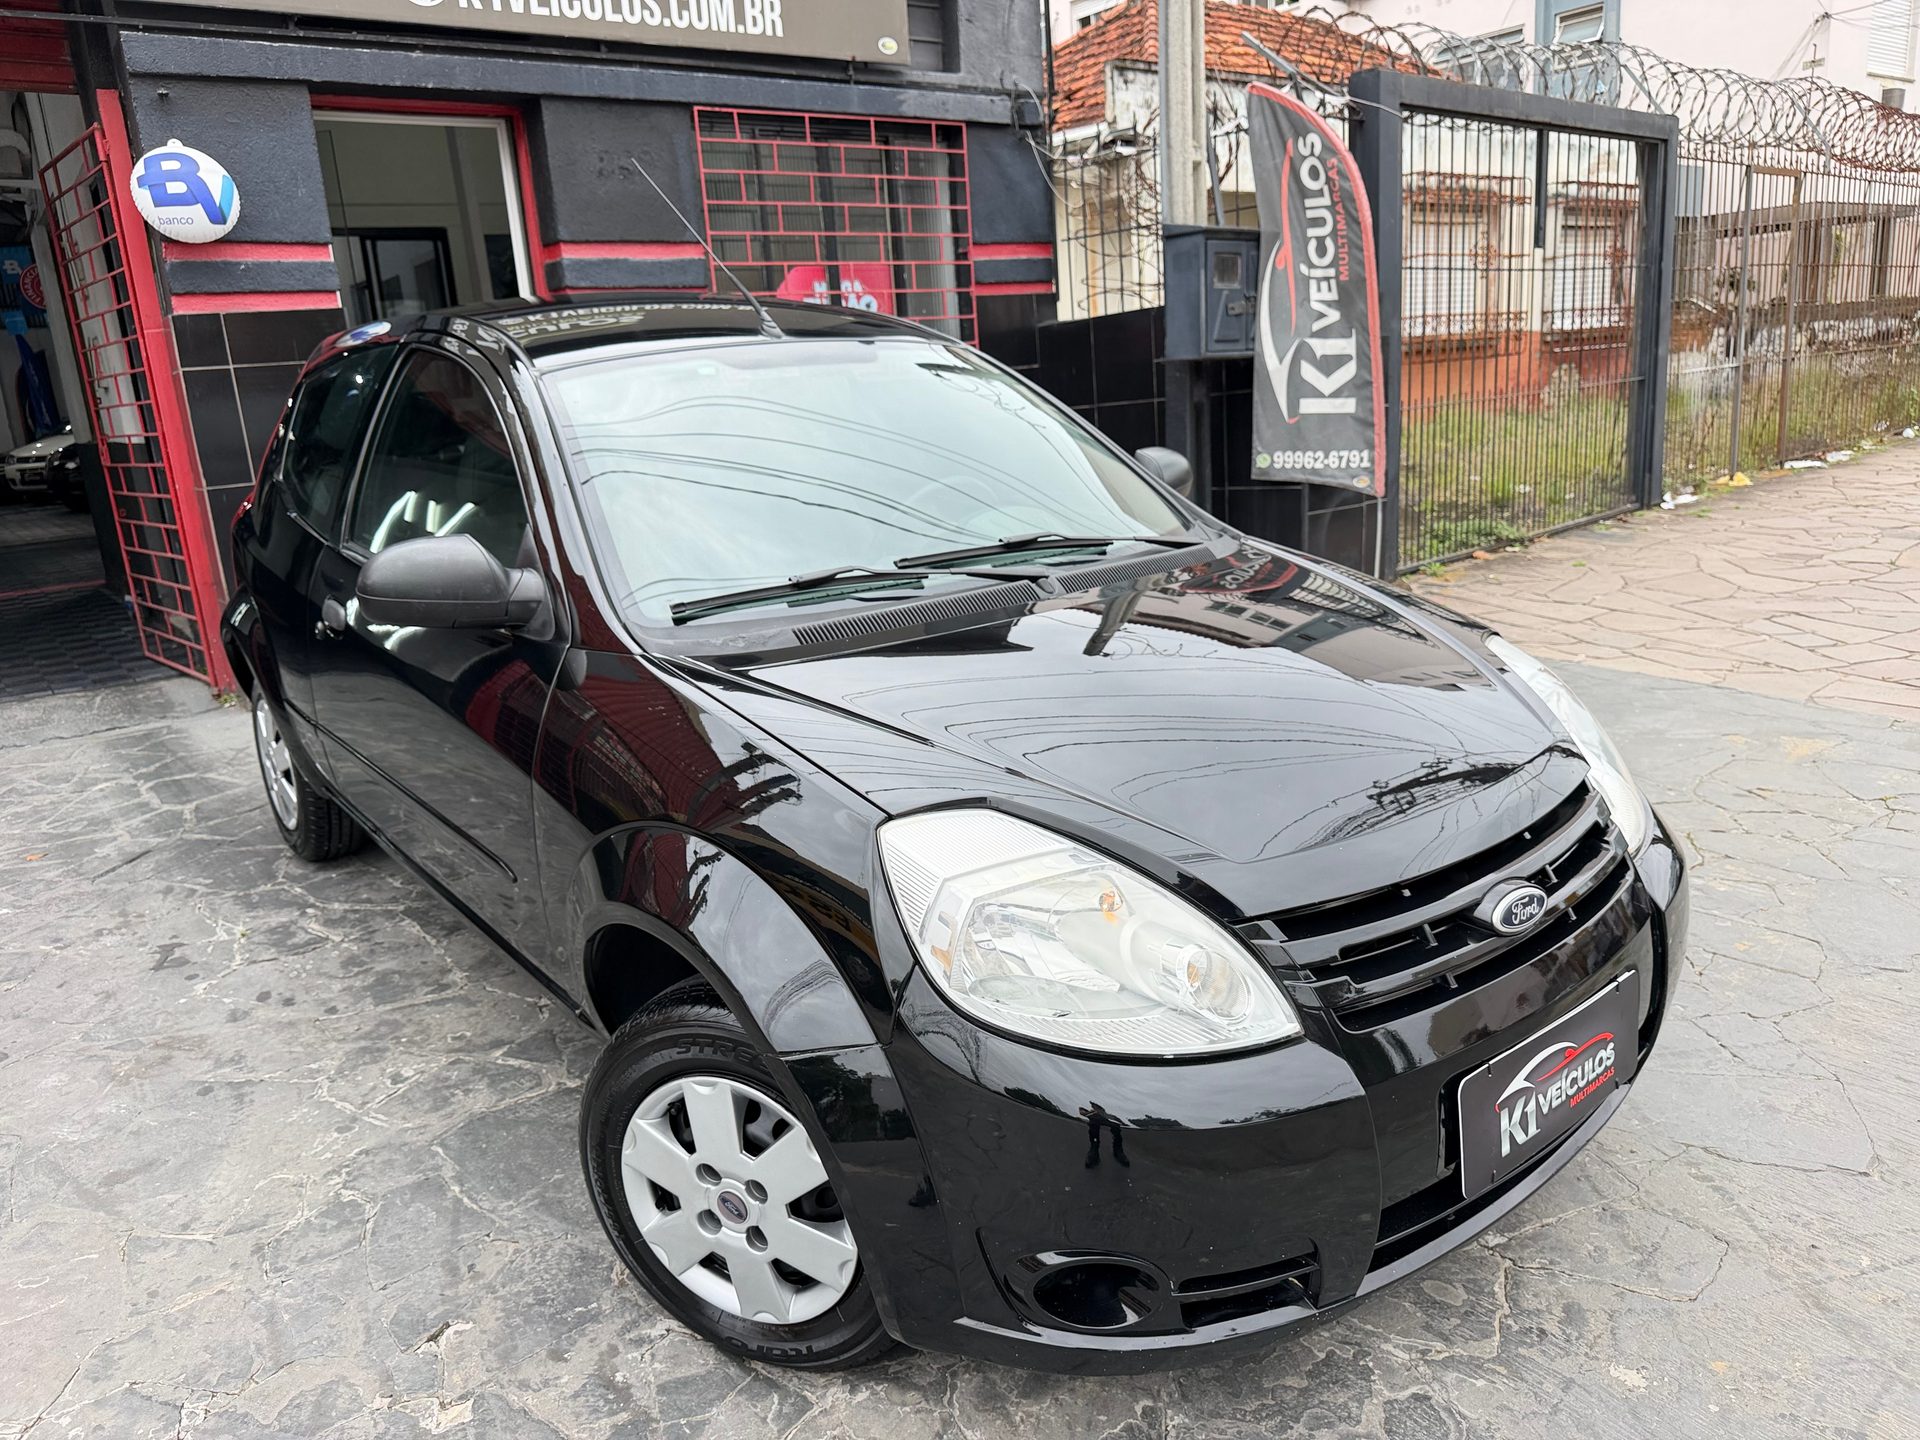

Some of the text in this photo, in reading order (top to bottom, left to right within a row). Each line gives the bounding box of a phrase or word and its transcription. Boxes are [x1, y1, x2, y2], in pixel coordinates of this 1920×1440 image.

[158, 215, 194, 226] banco
[1326, 156, 1349, 281] MULTIMARCAS
[1297, 131, 1358, 415] K1 VEÍCULOS
[1273, 449, 1371, 469] 99962-6791
[1511, 896, 1540, 925] Ford
[1500, 1042, 1616, 1158] K1 VEÍCULOS
[1569, 1066, 1615, 1108] MULTIMARCAS
